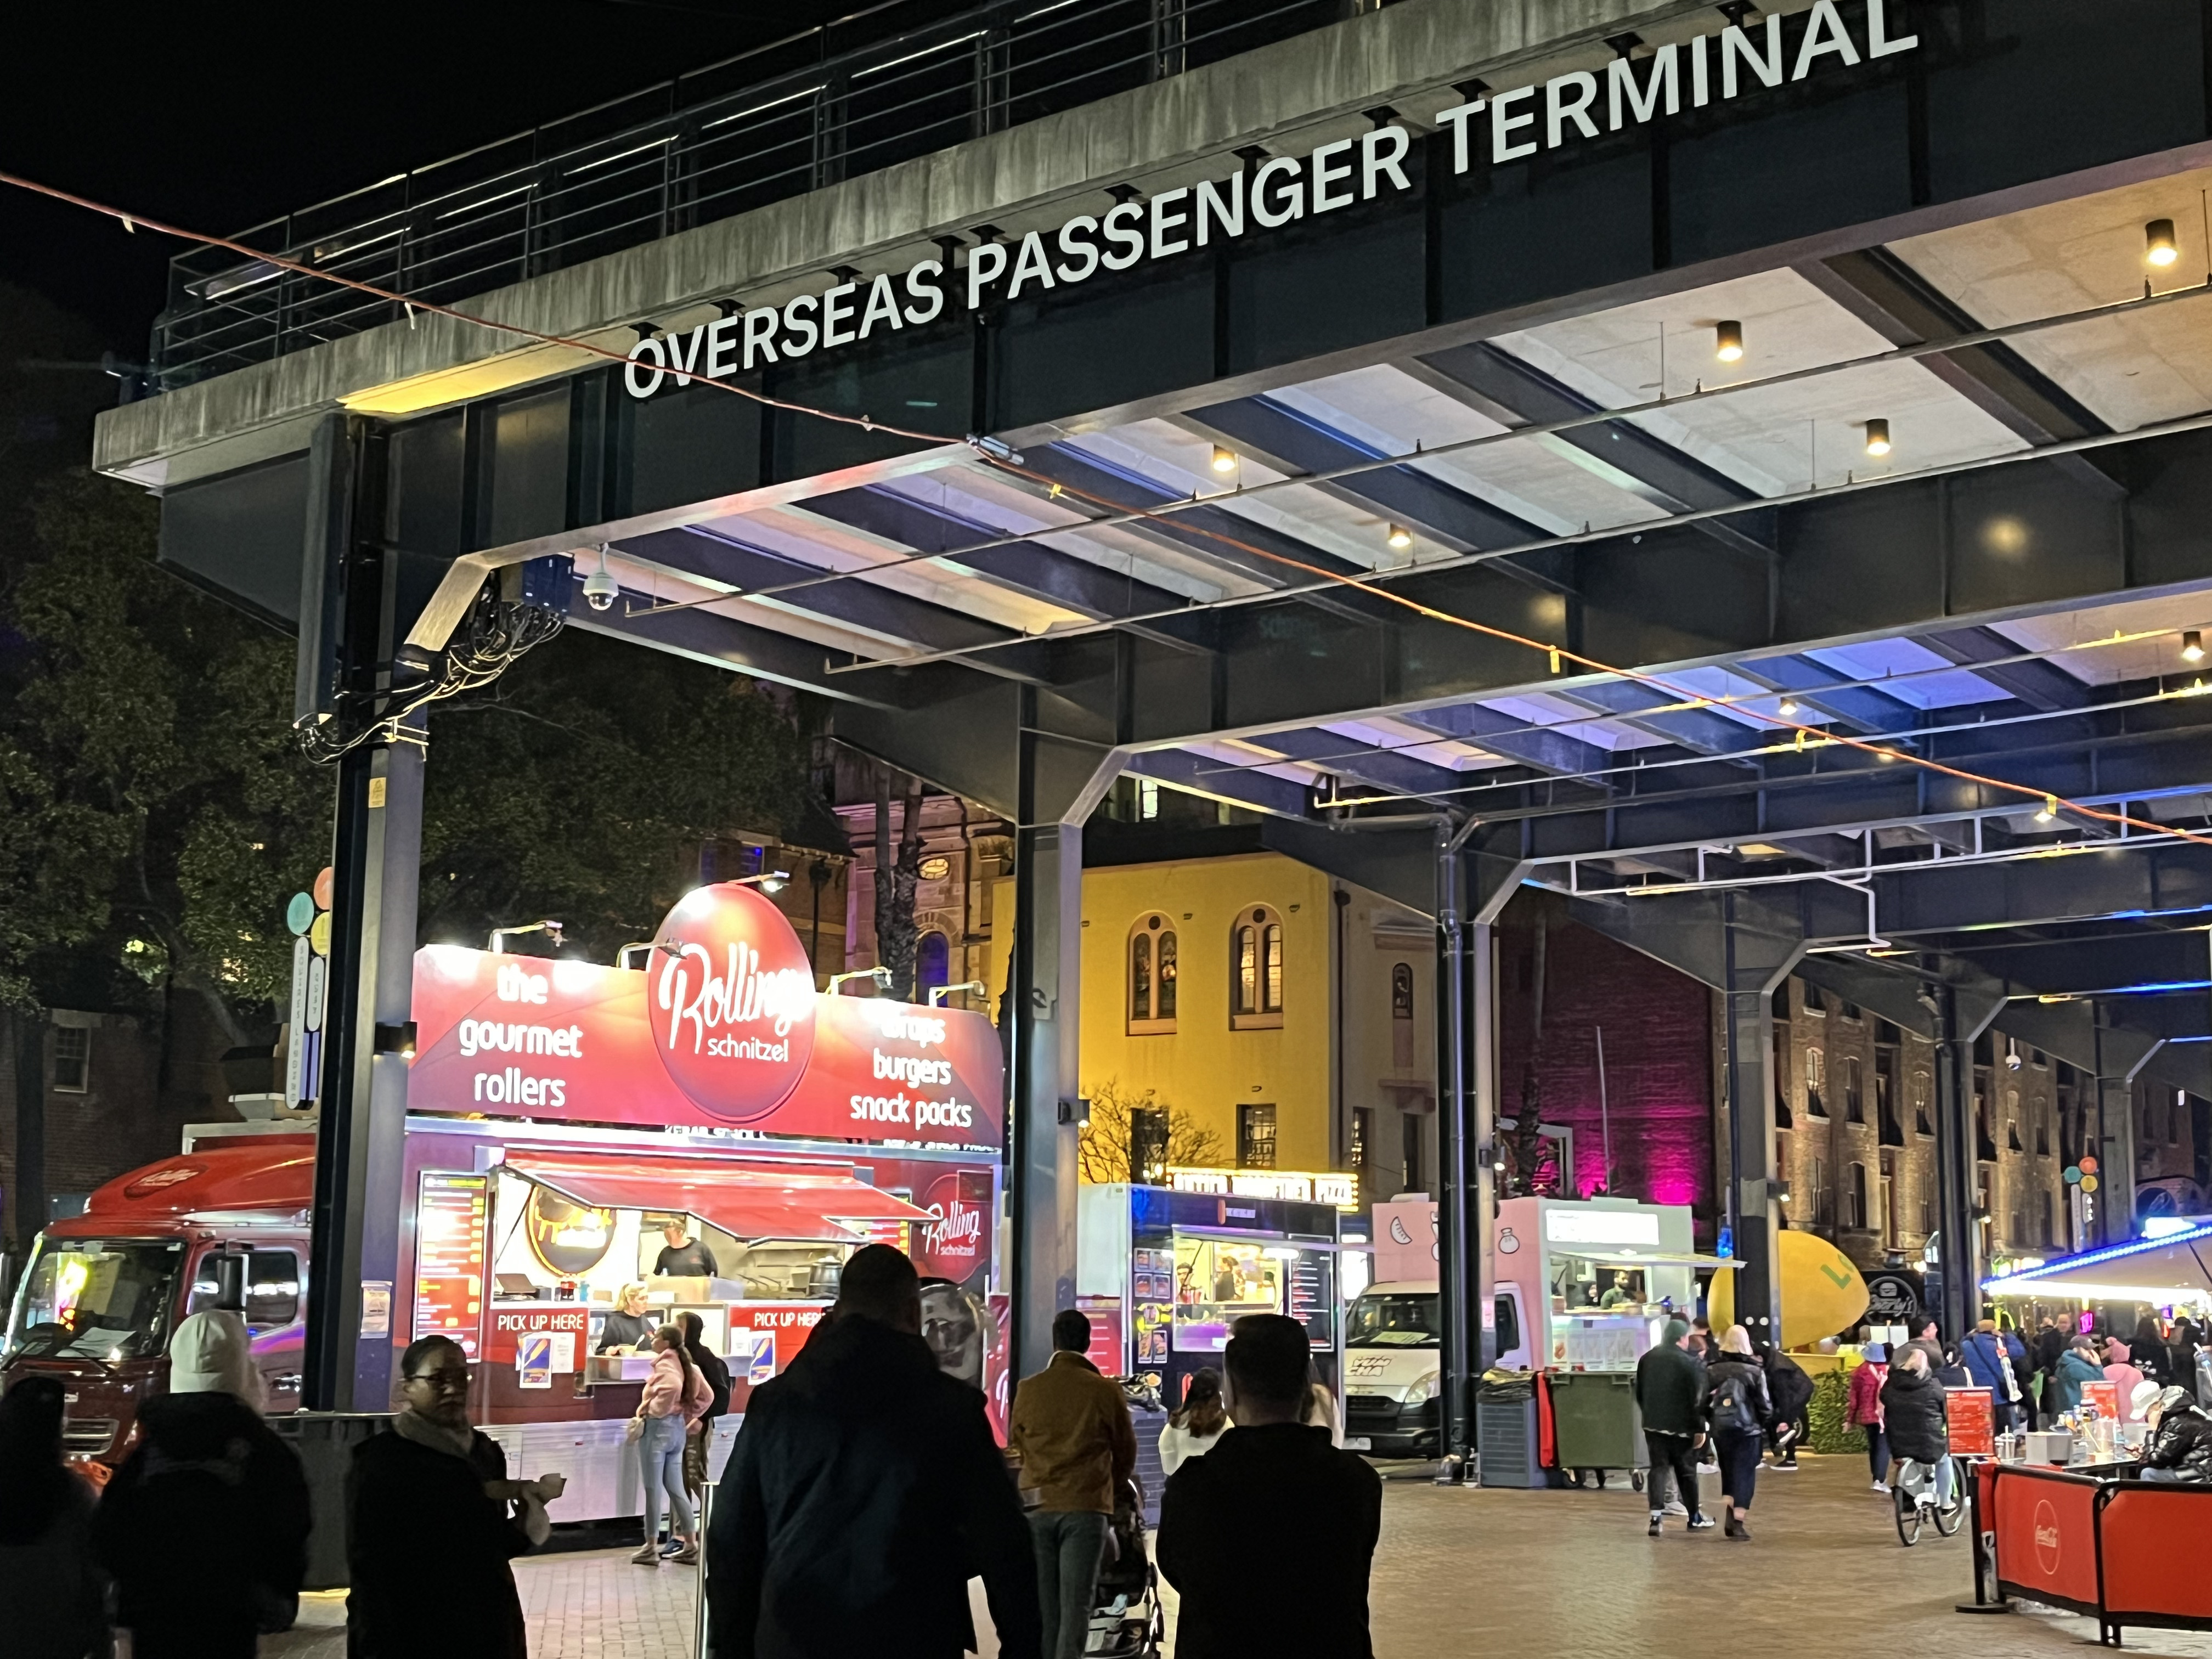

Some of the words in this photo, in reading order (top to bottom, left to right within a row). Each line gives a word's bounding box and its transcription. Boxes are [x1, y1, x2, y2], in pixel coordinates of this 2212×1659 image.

[624, 259, 944, 399] OVERSEAS
[967, 125, 1412, 311] PASSENGER
[1435, 0, 1918, 175] TERMINAL
[497, 963, 549, 1005] the
[459, 1018, 584, 1059] gourmet
[707, 1032, 789, 1063] schnitzel
[474, 1066, 566, 1107] rollers
[873, 1047, 952, 1089] burgers
[850, 1092, 911, 1124] snack
[915, 1097, 973, 1131] packs
[922, 1200, 981, 1255] Rolling
[498, 1313, 526, 1331] PICK
[529, 1313, 549, 1331] UP
[550, 1313, 584, 1330] HERE
[754, 1312, 778, 1328] PICK
[780, 1312, 795, 1327] UP
[797, 1312, 826, 1327] HER
